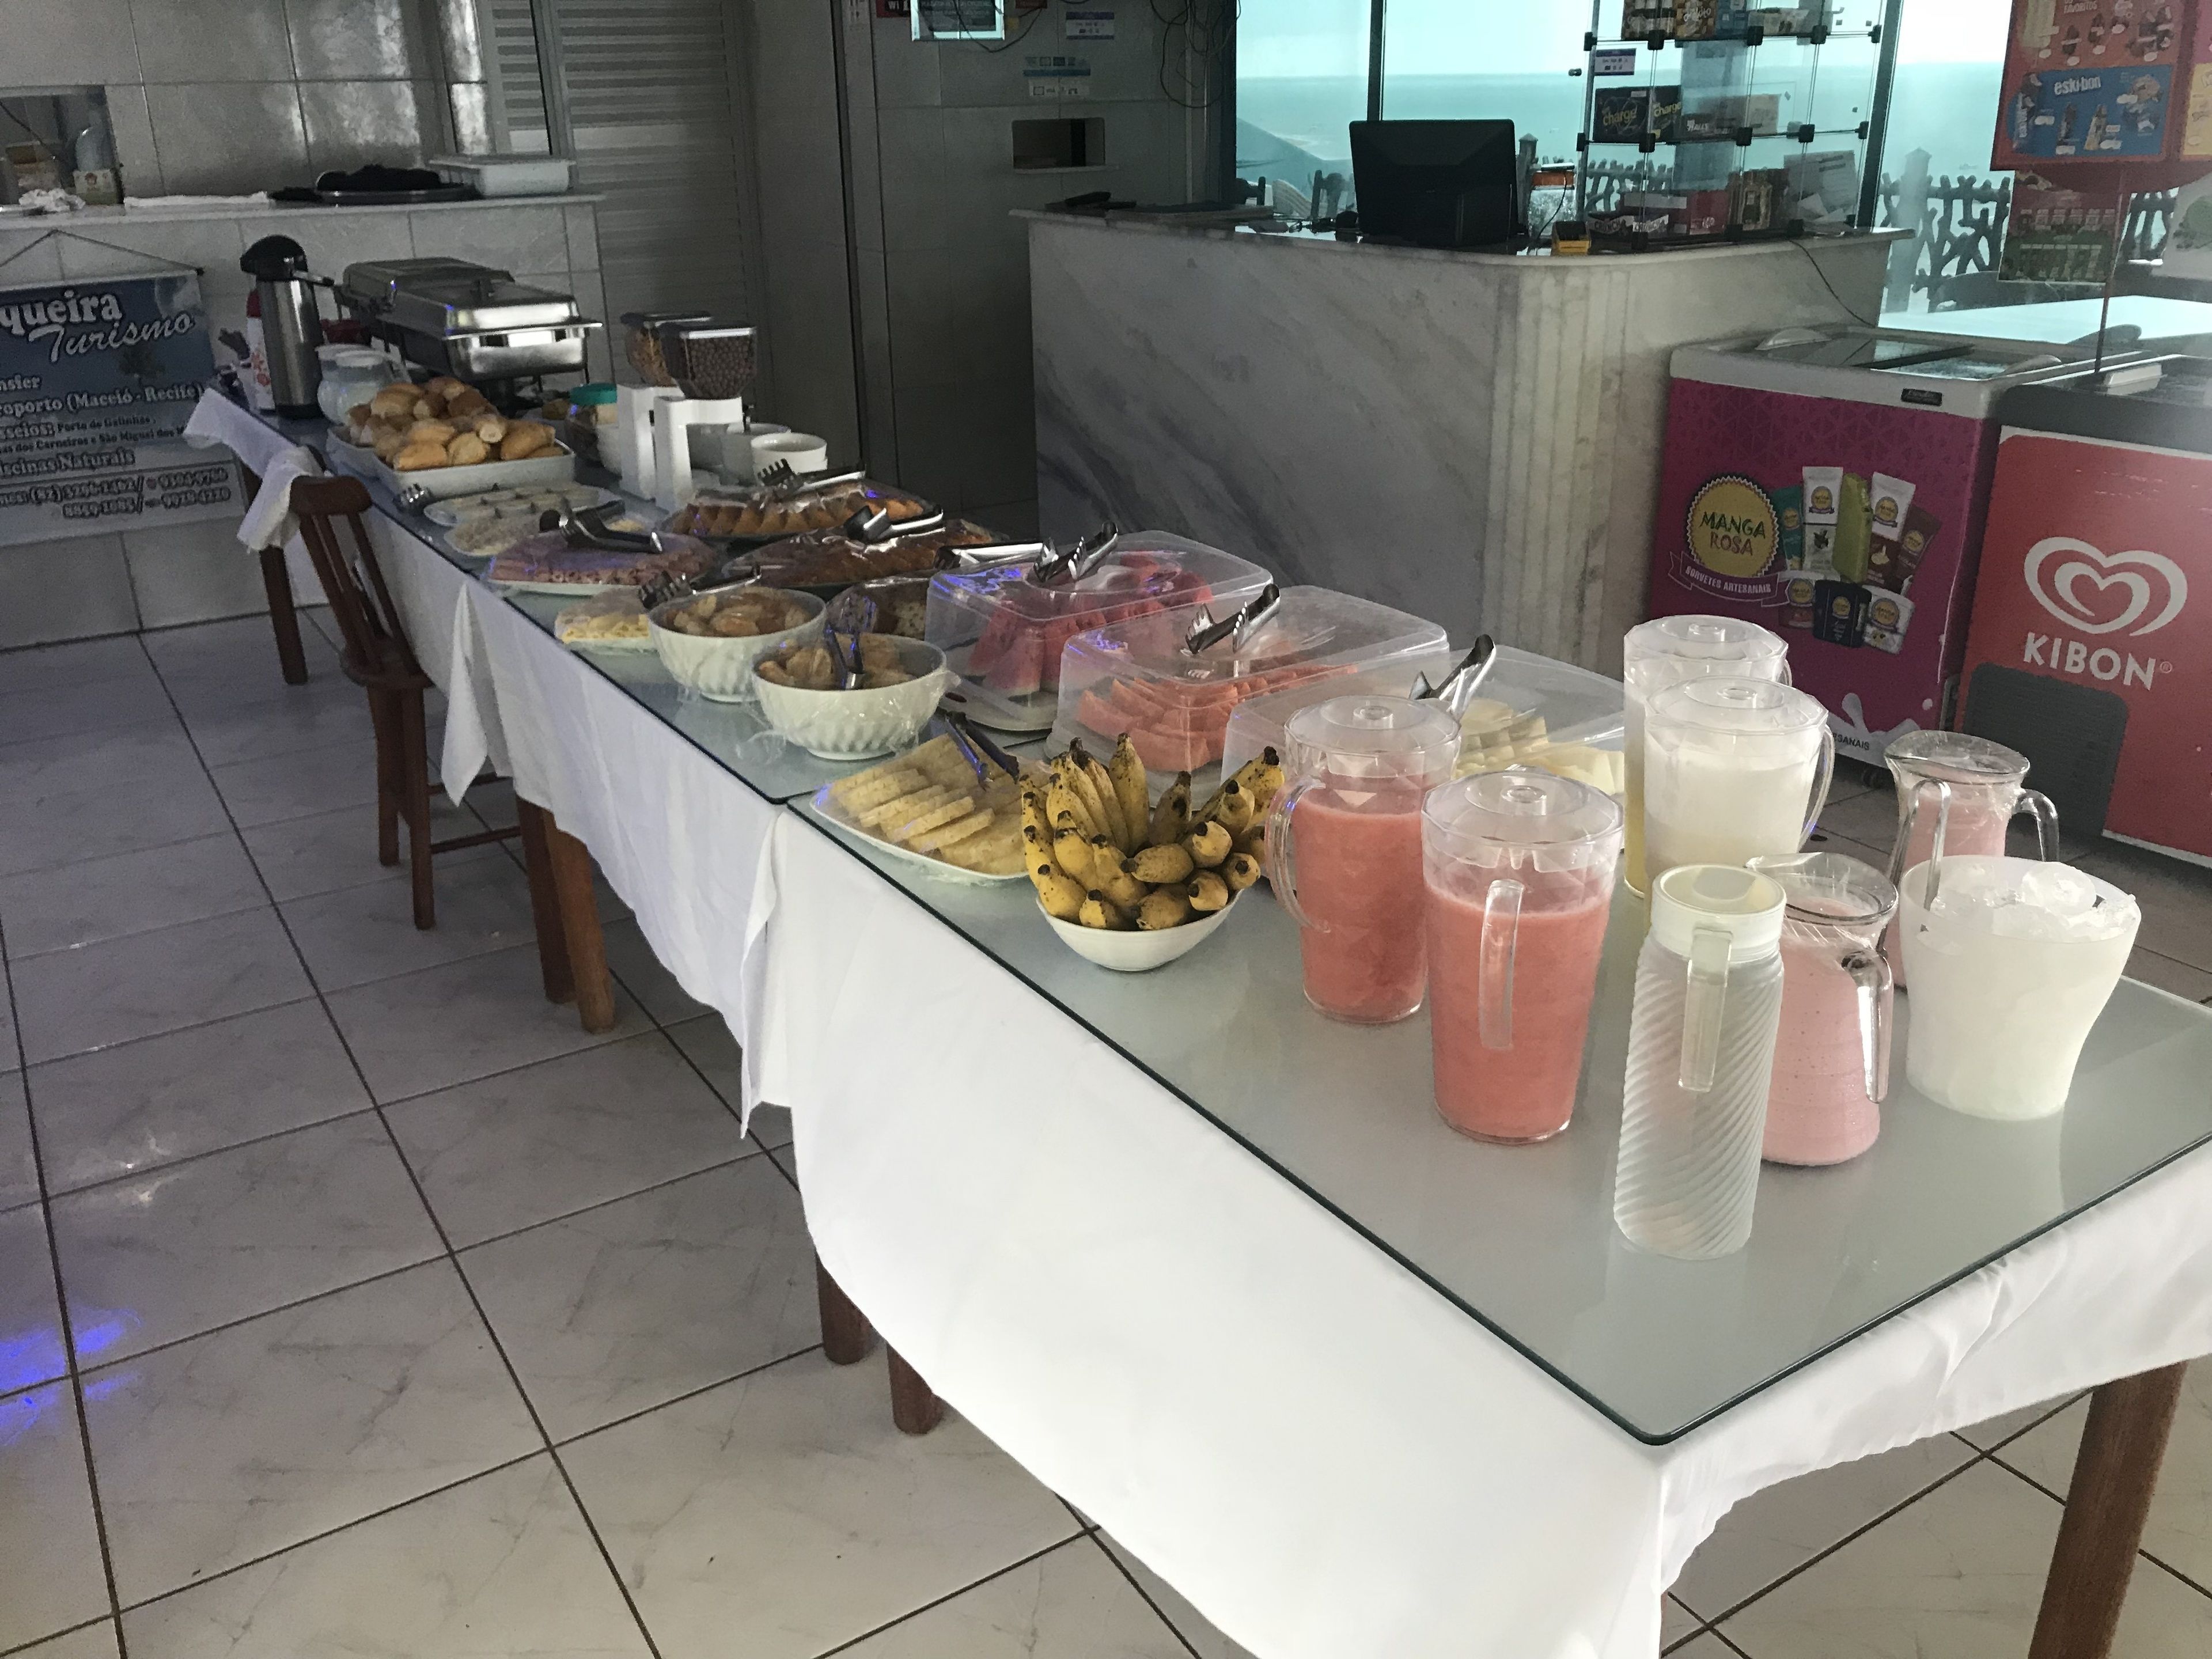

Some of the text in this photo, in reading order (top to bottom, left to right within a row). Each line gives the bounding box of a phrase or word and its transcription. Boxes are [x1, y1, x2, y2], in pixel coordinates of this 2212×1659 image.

[1603, 106, 1637, 126] charge
[0, 289, 122, 335] queira
[28, 313, 194, 362] Turismo
[1699, 510, 1766, 539] MANGA
[1709, 530, 1753, 556] ROSA
[1685, 565, 1722, 588] SORVETES
[1723, 581, 1772, 594] ARTESANAIS
[2023, 631, 2156, 691] KIBON
